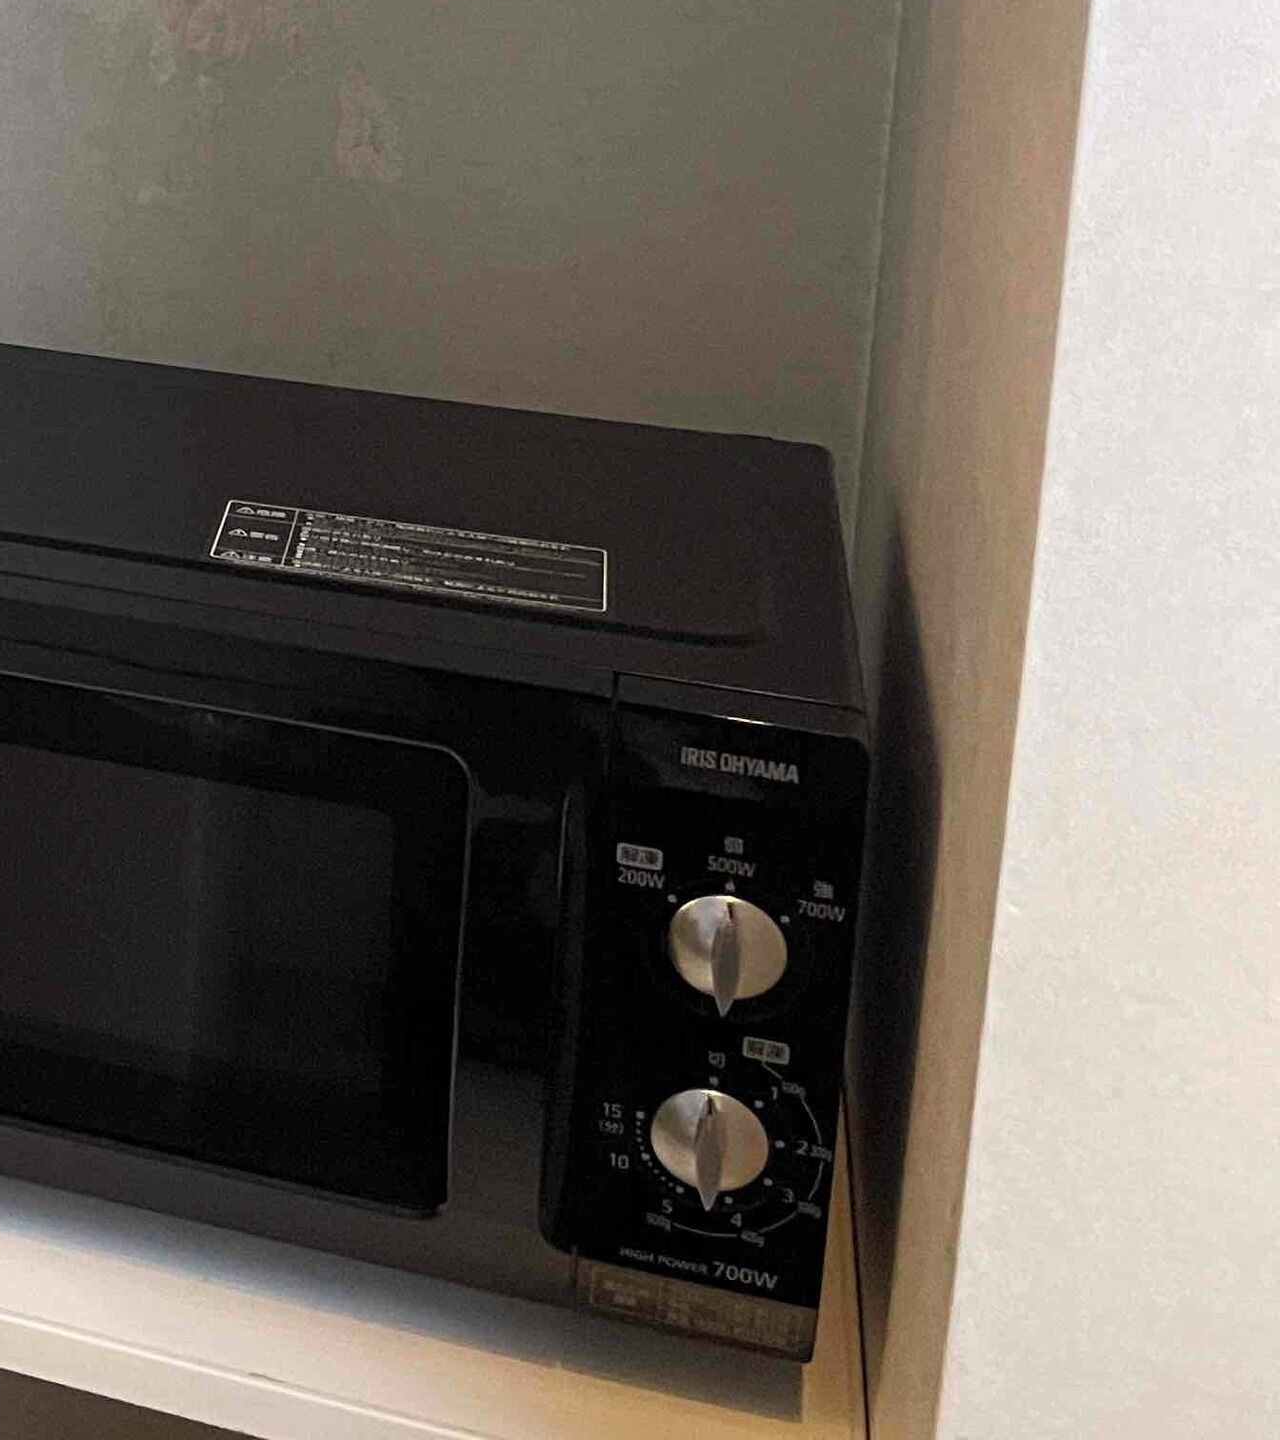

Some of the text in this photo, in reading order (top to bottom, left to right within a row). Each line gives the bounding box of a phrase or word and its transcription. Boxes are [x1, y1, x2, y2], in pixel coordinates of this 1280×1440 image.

[680, 746, 800, 785] IRIS OHYAMA
[707, 856, 756, 878] 500W
[617, 867, 665, 889] 200W
[797, 898, 846, 922] 700W
[770, 1086, 778, 1101] 1
[603, 1102, 622, 1118] 15
[795, 1140, 809, 1155] 2
[609, 1152, 629, 1170] 10
[781, 1188, 794, 1203] 3
[662, 1198, 672, 1214] 5
[730, 1213, 743, 1228] 4
[657, 1255, 708, 1275] POWER
[712, 1261, 778, 1289] 700W
